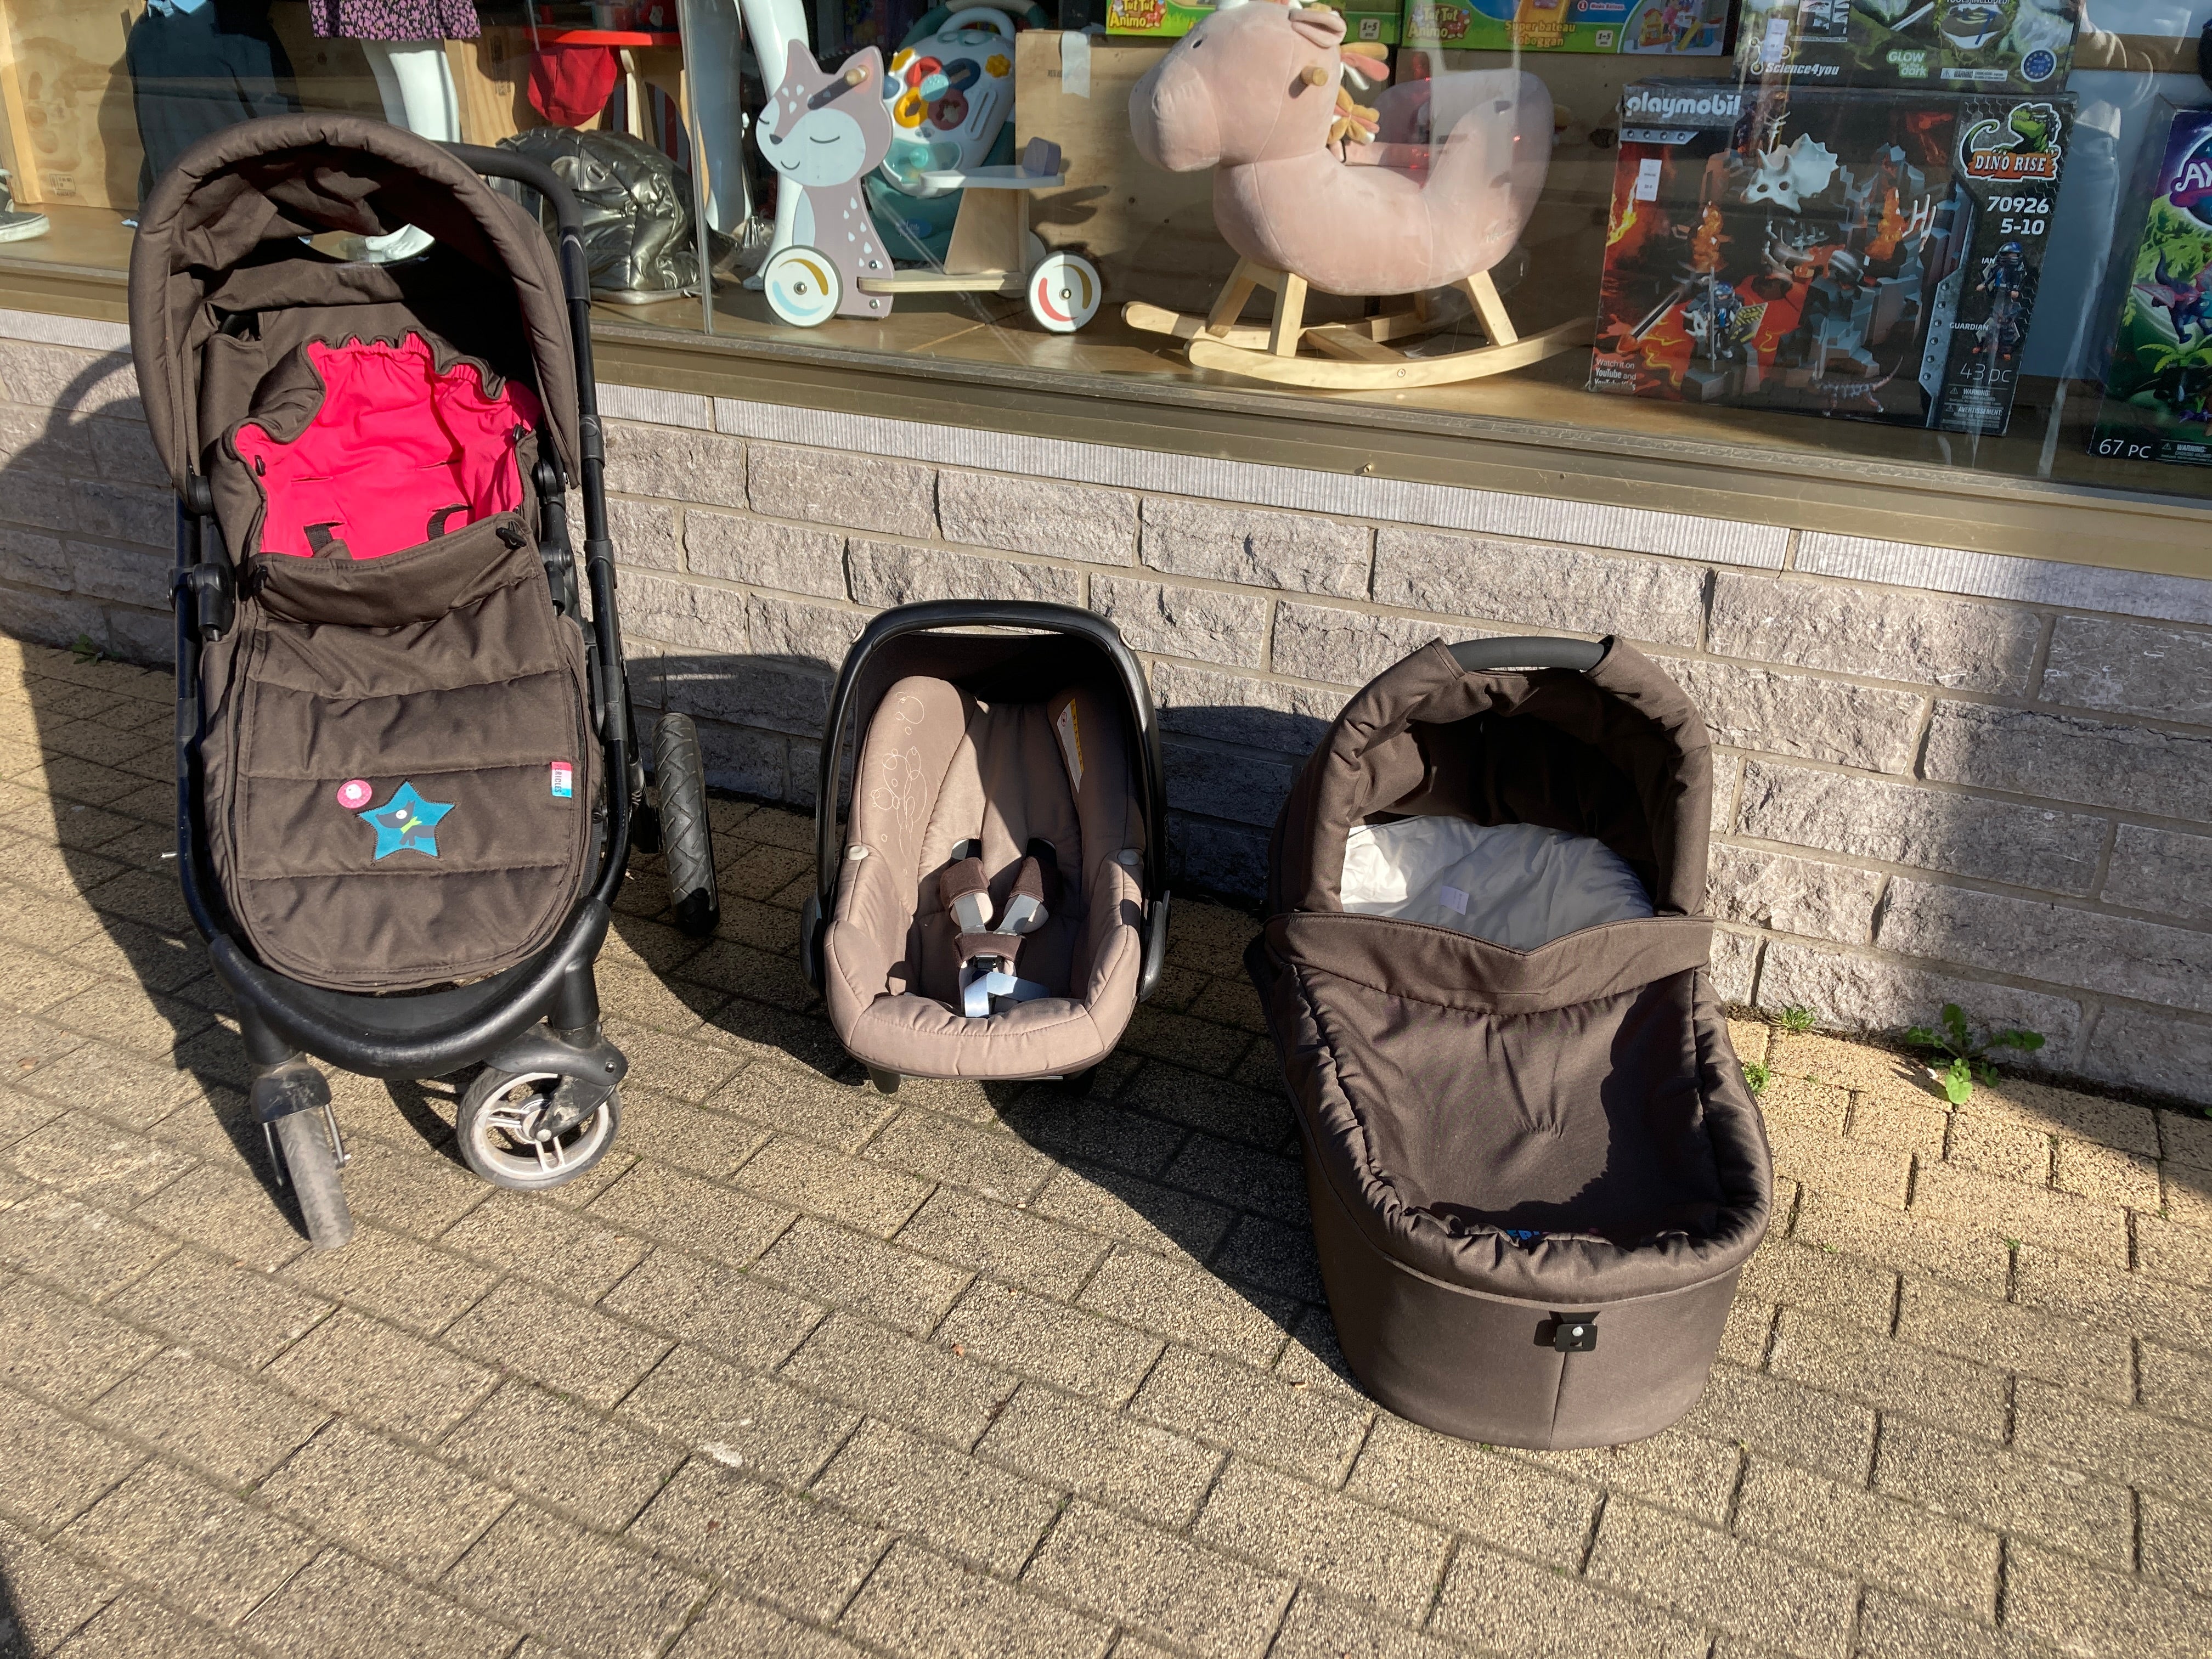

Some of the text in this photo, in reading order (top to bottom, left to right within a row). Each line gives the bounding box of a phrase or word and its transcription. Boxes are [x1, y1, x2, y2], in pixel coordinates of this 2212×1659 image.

[1110, 12, 1147, 28] Animo
[1441, 7, 1458, 22] Tut
[1362, 22, 1378, 31] 1-5
[1407, 22, 1448, 38] Animo
[1538, 21, 1576, 32] bateau
[1513, 34, 1564, 48] oboggan
[1888, 51, 1925, 63] GLOW
[1765, 61, 1841, 77] Science4you
[1626, 92, 1742, 118] playmobil
[1975, 154, 2047, 172] DINO RISE
[1987, 196, 2050, 214] 70926
[2000, 218, 2046, 235] 5-10
[1949, 322, 1989, 331] GUARDIAN
[1596, 358, 1618, 367] Watch
[1595, 367, 1622, 379] YouTube
[1960, 363, 1985, 380] 43
[2100, 438, 2124, 455] 67
[554, 764, 562, 793] PERICLES
